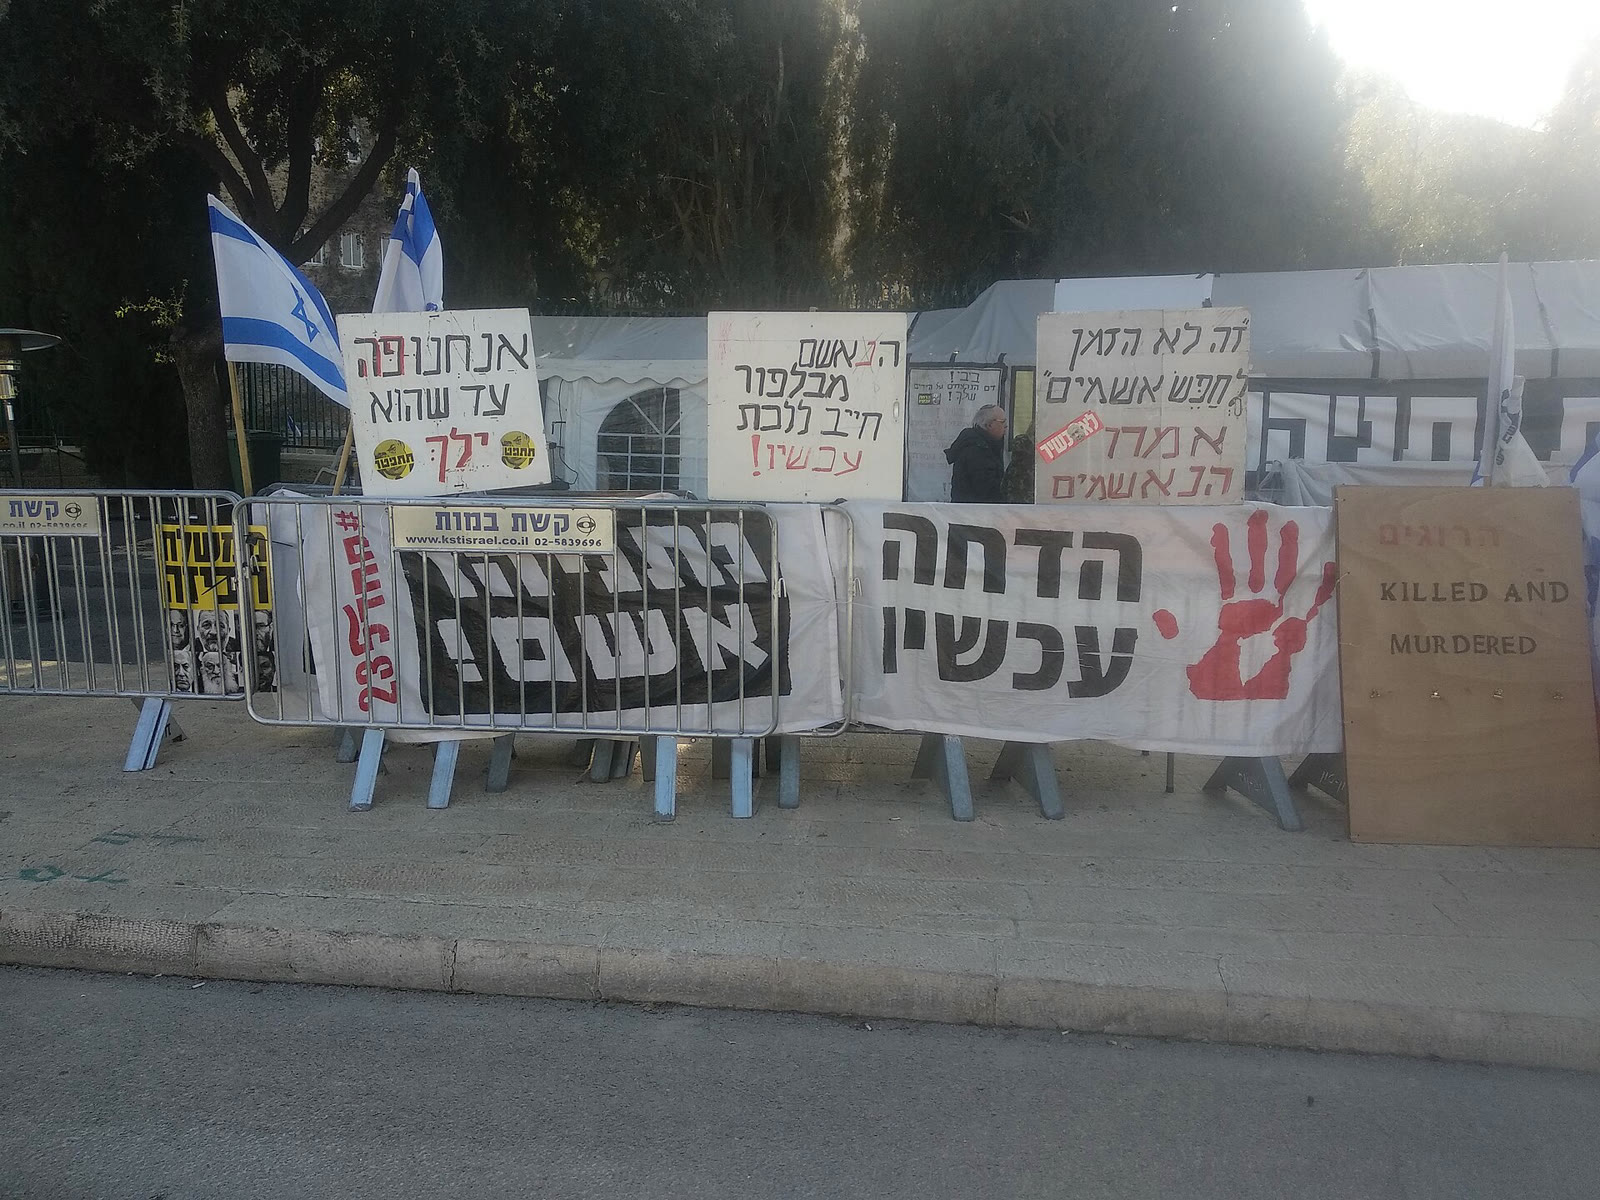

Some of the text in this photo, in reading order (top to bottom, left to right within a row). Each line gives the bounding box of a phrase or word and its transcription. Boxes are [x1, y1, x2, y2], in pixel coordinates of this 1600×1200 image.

[354, 333, 529, 378] אנחנו פה
[1068, 328, 1142, 371] הזמן
[1153, 322, 1202, 355] לא
[734, 362, 850, 402] מבלפור
[369, 383, 510, 424] עד שהוא
[736, 400, 812, 435] ללכת
[820, 407, 883, 441] חייב
[426, 427, 489, 483] ילך
[751, 434, 863, 477] עכשיו!
[1052, 465, 1235, 500] הנאשמים
[9, 500, 60, 521] קשת
[435, 511, 570, 536] קשת במות
[405, 535, 602, 547] www.kstisrael.co.il 02-5839696
[882, 512, 1143, 602] הדחה
[1380, 580, 1570, 603] KILLED AND
[437, 603, 769, 682] אשם!
[882, 606, 1139, 698] עכשיו
[1390, 633, 1538, 655] MURDERED
